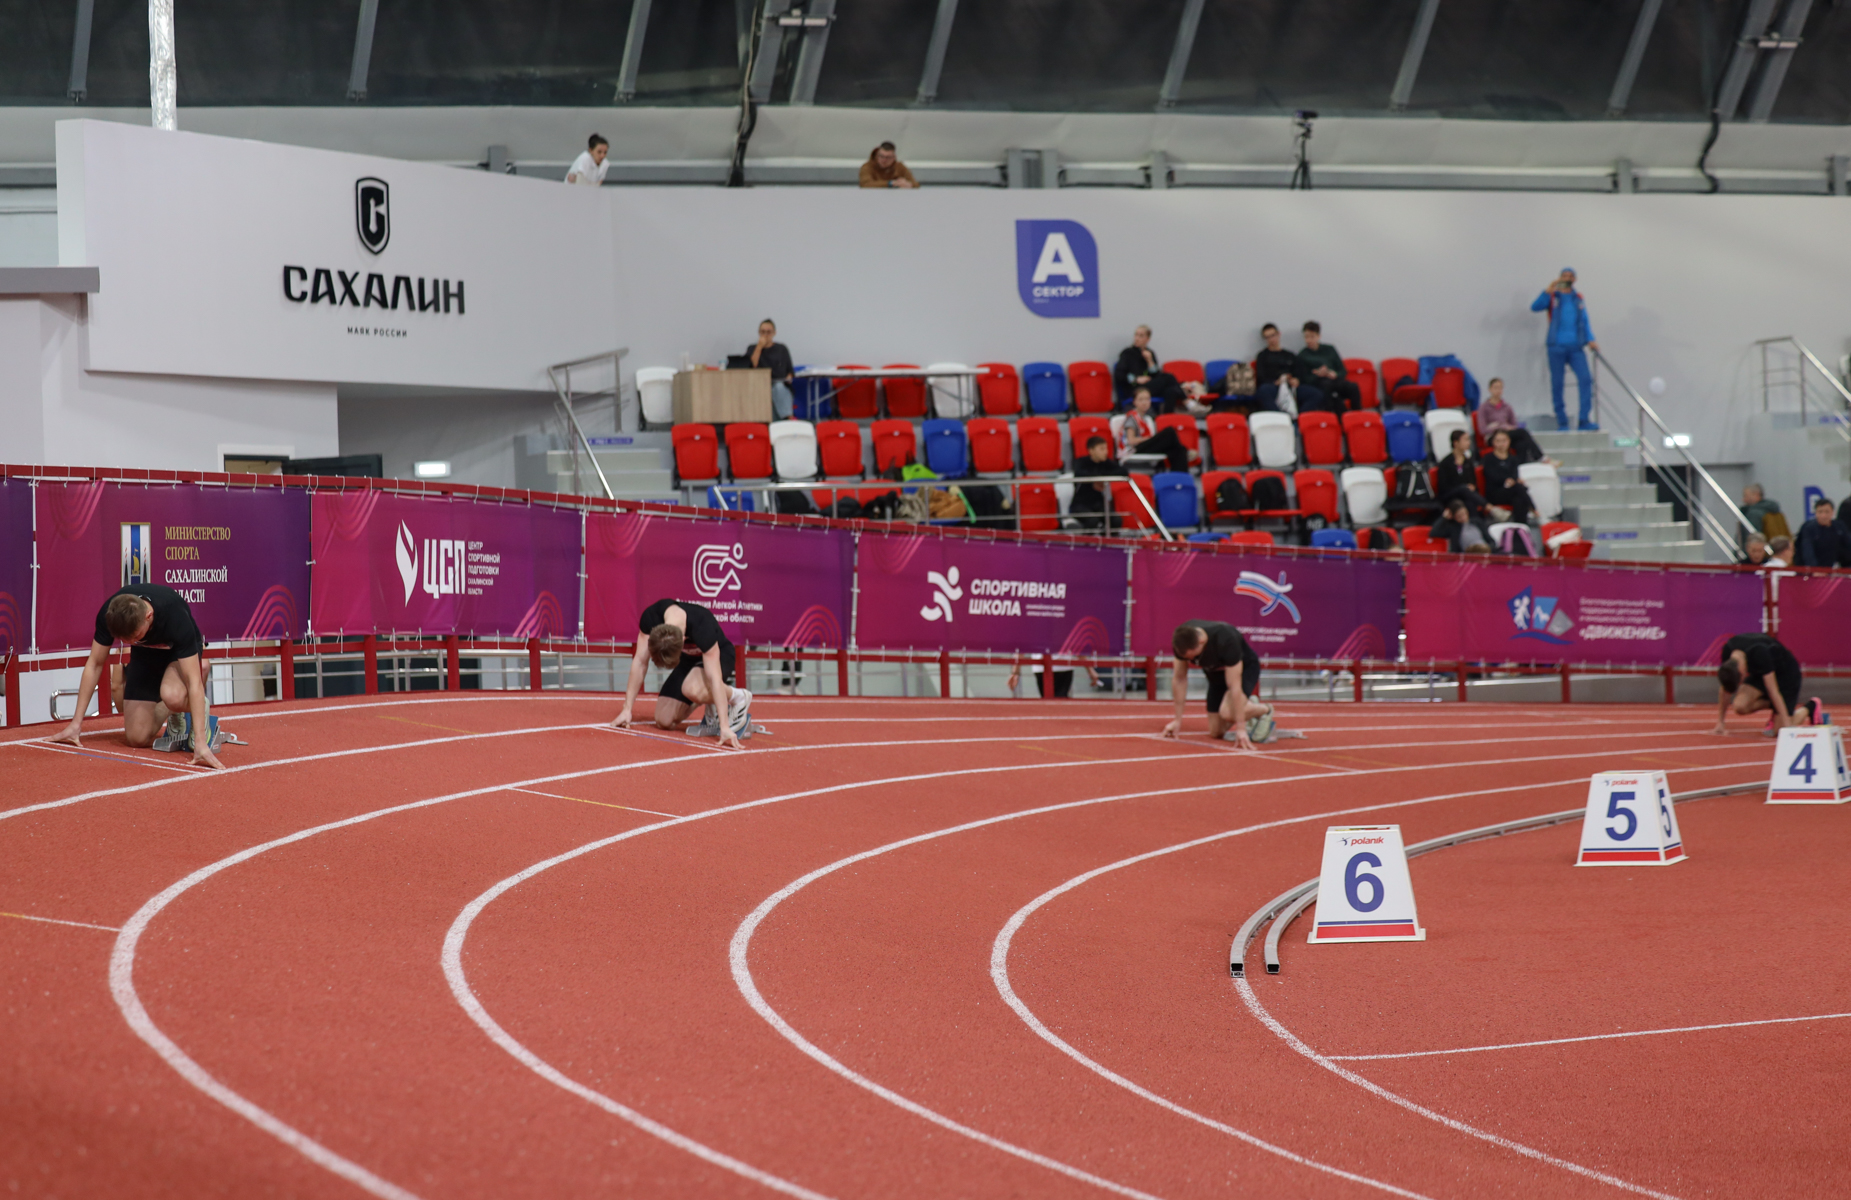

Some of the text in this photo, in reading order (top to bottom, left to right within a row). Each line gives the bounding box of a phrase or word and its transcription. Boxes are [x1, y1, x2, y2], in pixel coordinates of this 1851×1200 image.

[1032, 232, 1084, 283] А
[283, 264, 466, 315] САХАЛИН
[1032, 286, 1085, 297] СЕКТОР
[347, 326, 408, 338] МАЯК РОССИИ
[165, 526, 231, 541] МИНИСТЕРСТВО
[165, 546, 200, 560] СПОРТА
[467, 541, 484, 551] ЦЕНТР
[467, 553, 501, 564] СПОРТИВНОЙ
[165, 565, 228, 583] САХАЛИНСКОЙ
[423, 538, 466, 599] ЦСП
[467, 564, 500, 576] ПОДГОТОВКИ
[174, 589, 205, 603] ЛАСТИ
[970, 578, 1067, 599] СПОРТИВНАЯ
[712, 599, 737, 610] Легкой
[738, 600, 764, 612] Атлетики
[968, 598, 1022, 617] ШКОЛА
[729, 612, 755, 623] области
[1578, 624, 1667, 641] «ДВИЖЕНИЕ»
[1788, 742, 1818, 784] 4
[1605, 791, 1638, 842] 5
[1658, 788, 1672, 838] 5
[1350, 836, 1385, 847] polanik
[1344, 851, 1385, 913] 6
